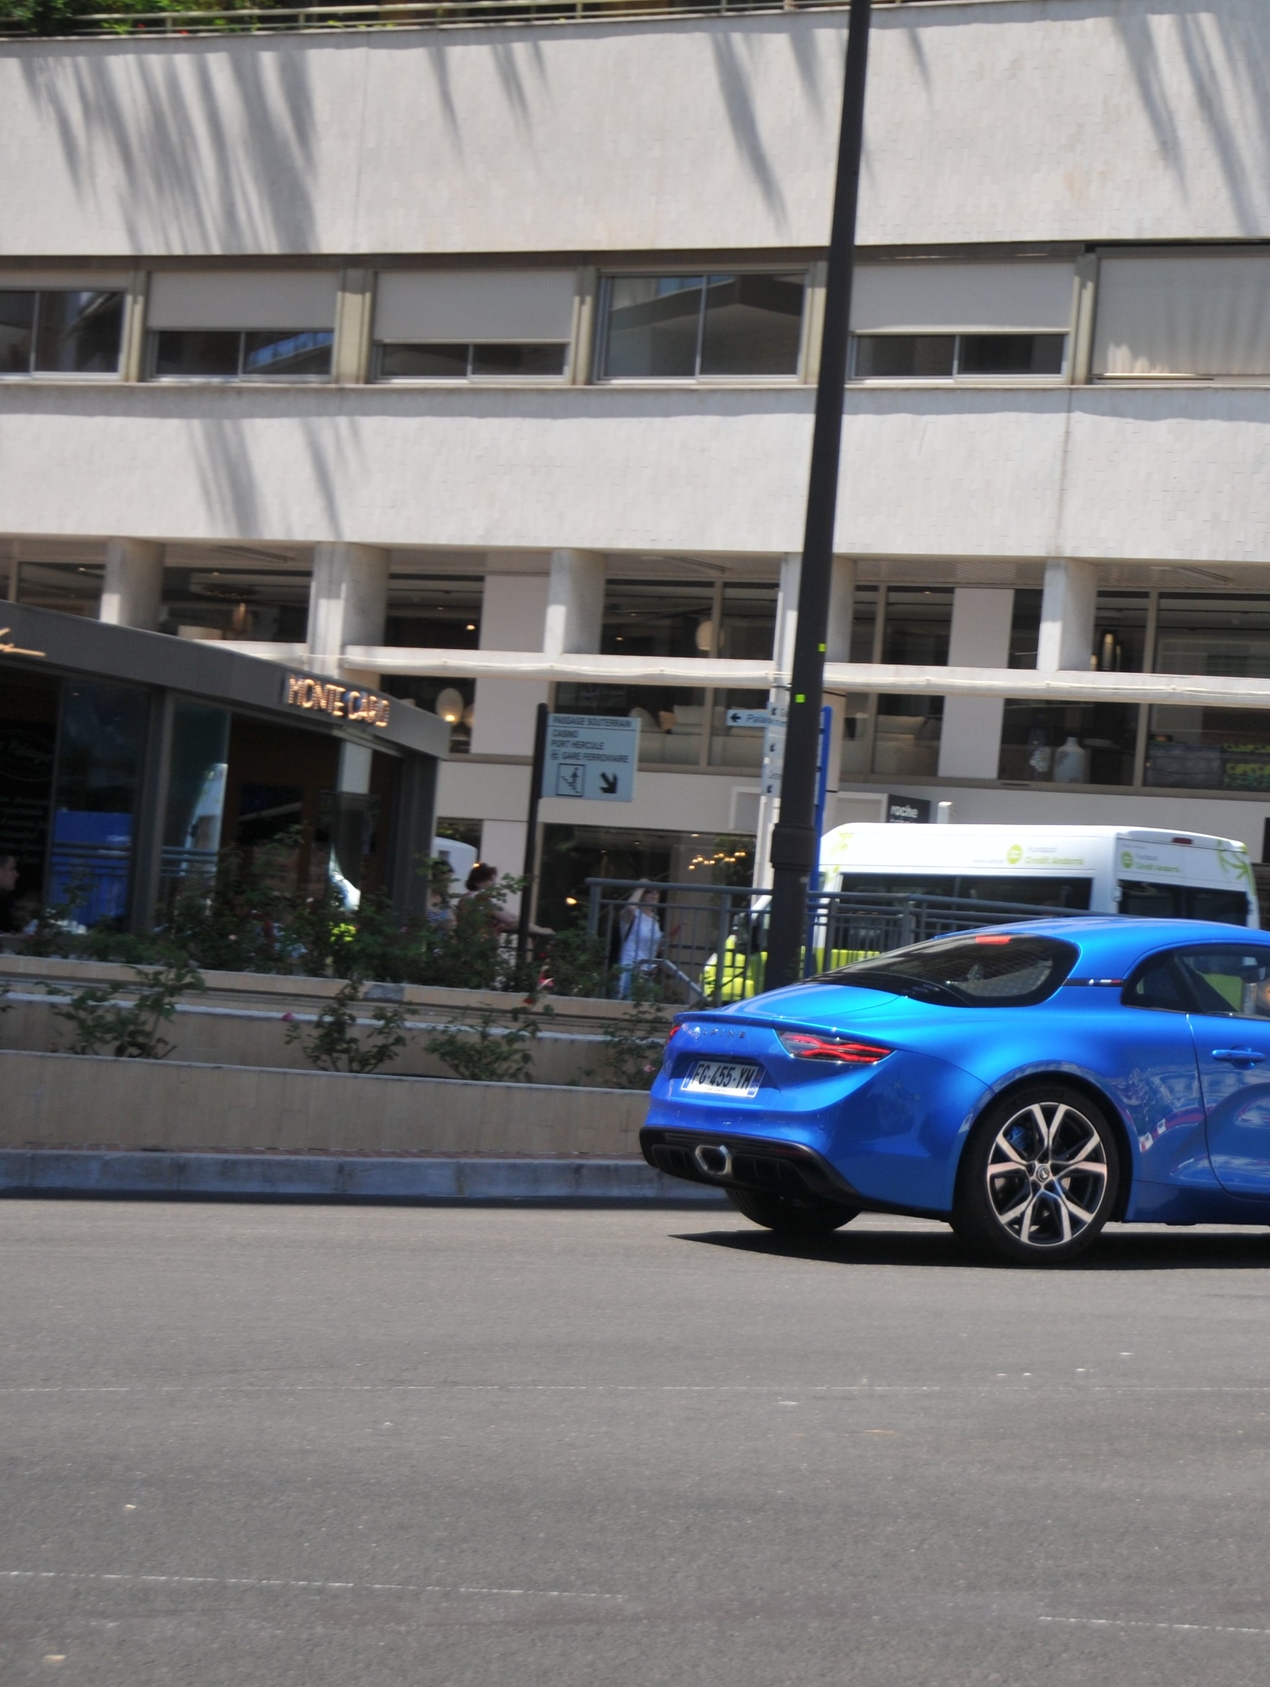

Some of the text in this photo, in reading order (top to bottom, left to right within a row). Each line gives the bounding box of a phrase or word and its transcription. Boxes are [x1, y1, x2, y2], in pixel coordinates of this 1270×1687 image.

[288, 677, 346, 717] MONTE
[553, 716, 585, 726] PASSAGE
[553, 729, 578, 738] CASINO
[551, 739, 605, 750] PORT HERCULE
[562, 751, 630, 763] GARE FERROVIAIRE
[890, 805, 919, 818] roche
